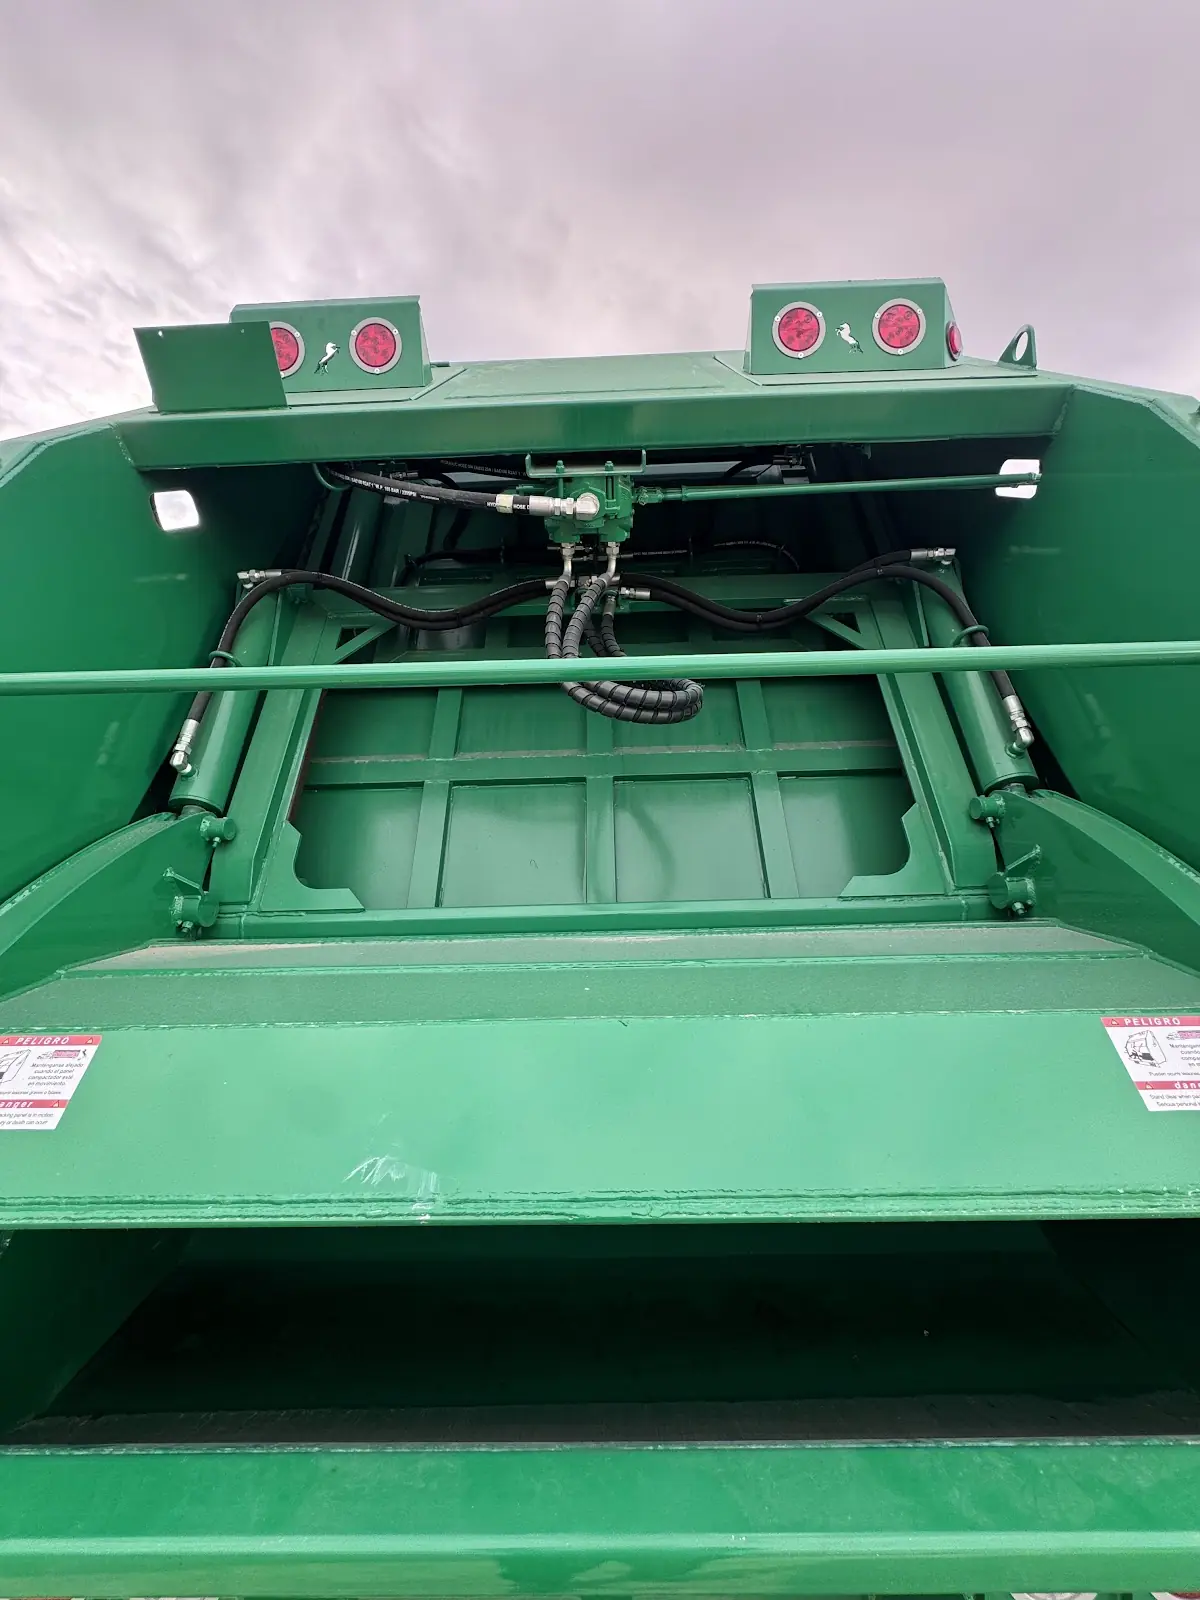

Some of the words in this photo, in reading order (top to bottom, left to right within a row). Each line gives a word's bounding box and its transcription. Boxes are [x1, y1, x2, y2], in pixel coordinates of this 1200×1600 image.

[1124, 1017, 1181, 1026] PELIGRO
[14, 1037, 70, 1045] PELIGRO
[0, 1101, 34, 1109] anger
